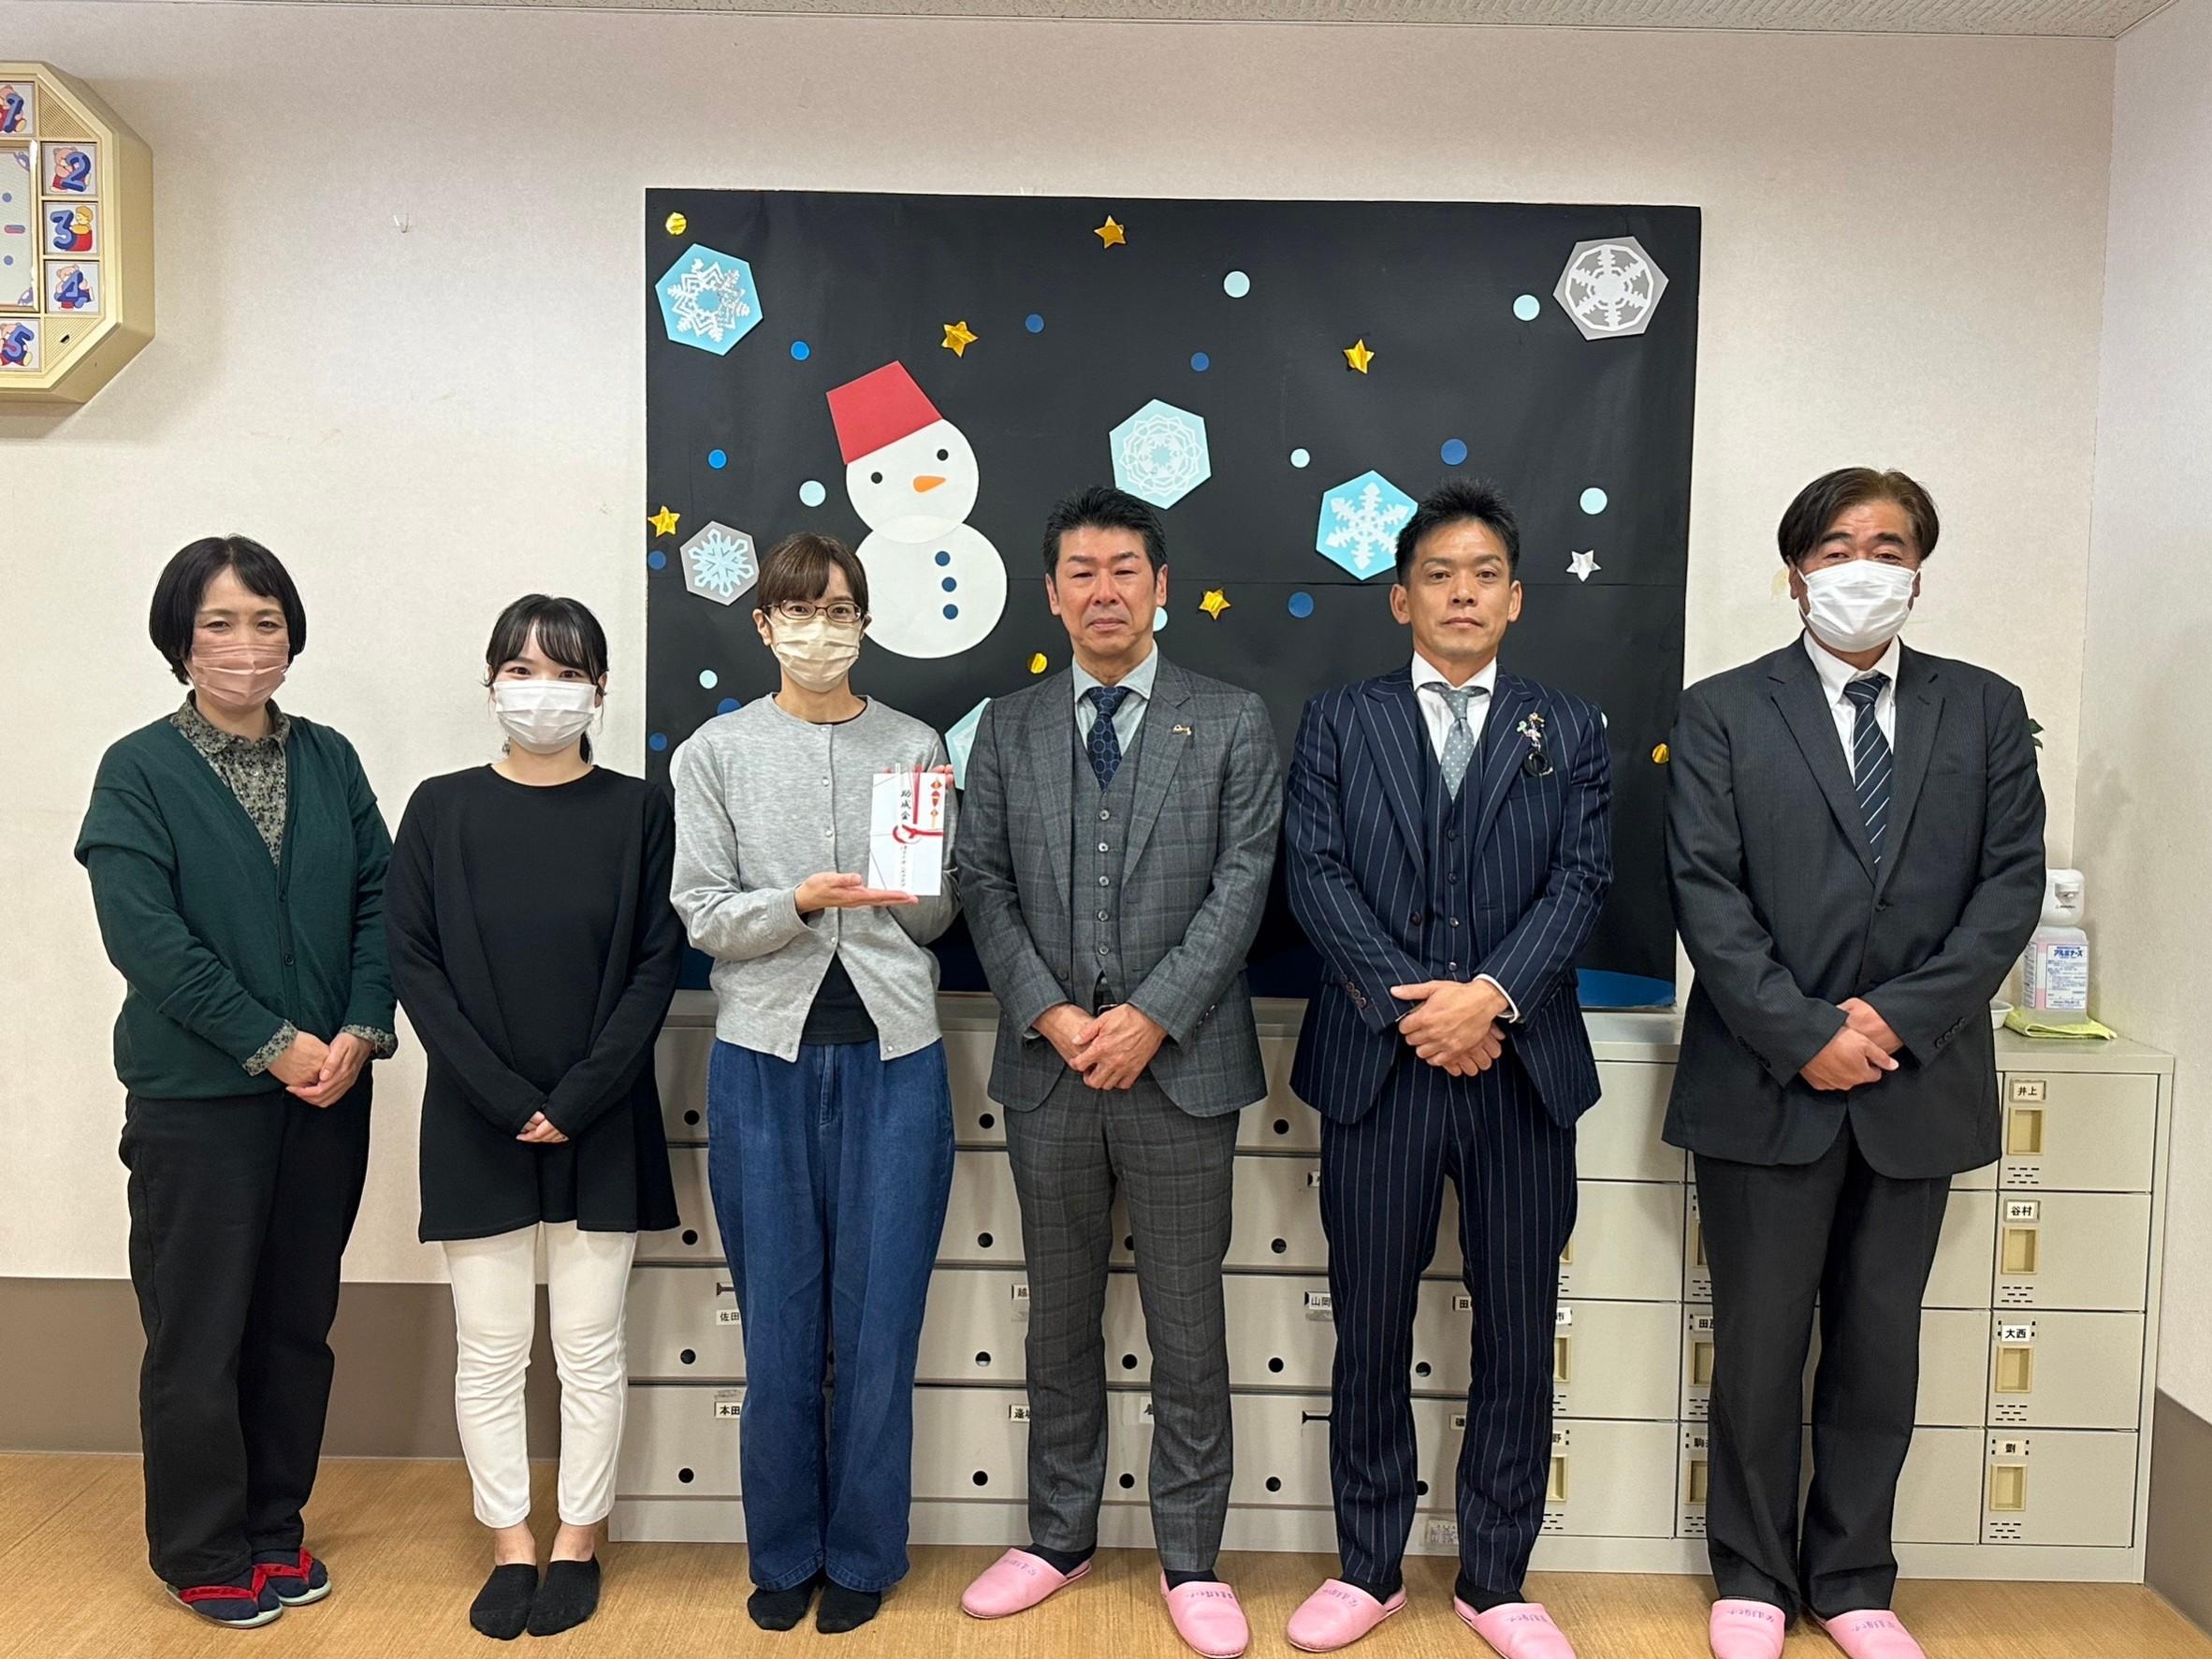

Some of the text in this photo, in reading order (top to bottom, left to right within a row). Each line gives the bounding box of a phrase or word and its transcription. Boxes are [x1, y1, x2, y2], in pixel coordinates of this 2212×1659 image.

[60, 152, 91, 192] 2
[50, 210, 77, 251] 3
[53, 269, 90, 308] 4
[3, 323, 35, 363] 5
[900, 789, 912, 821] 助成金
[2017, 1085, 2037, 1097] 井上
[2011, 1204, 2032, 1216] 谷村
[720, 1311, 739, 1322] 佐田
[2005, 1328, 2027, 1339] 大西
[720, 1404, 740, 1416] 本田
